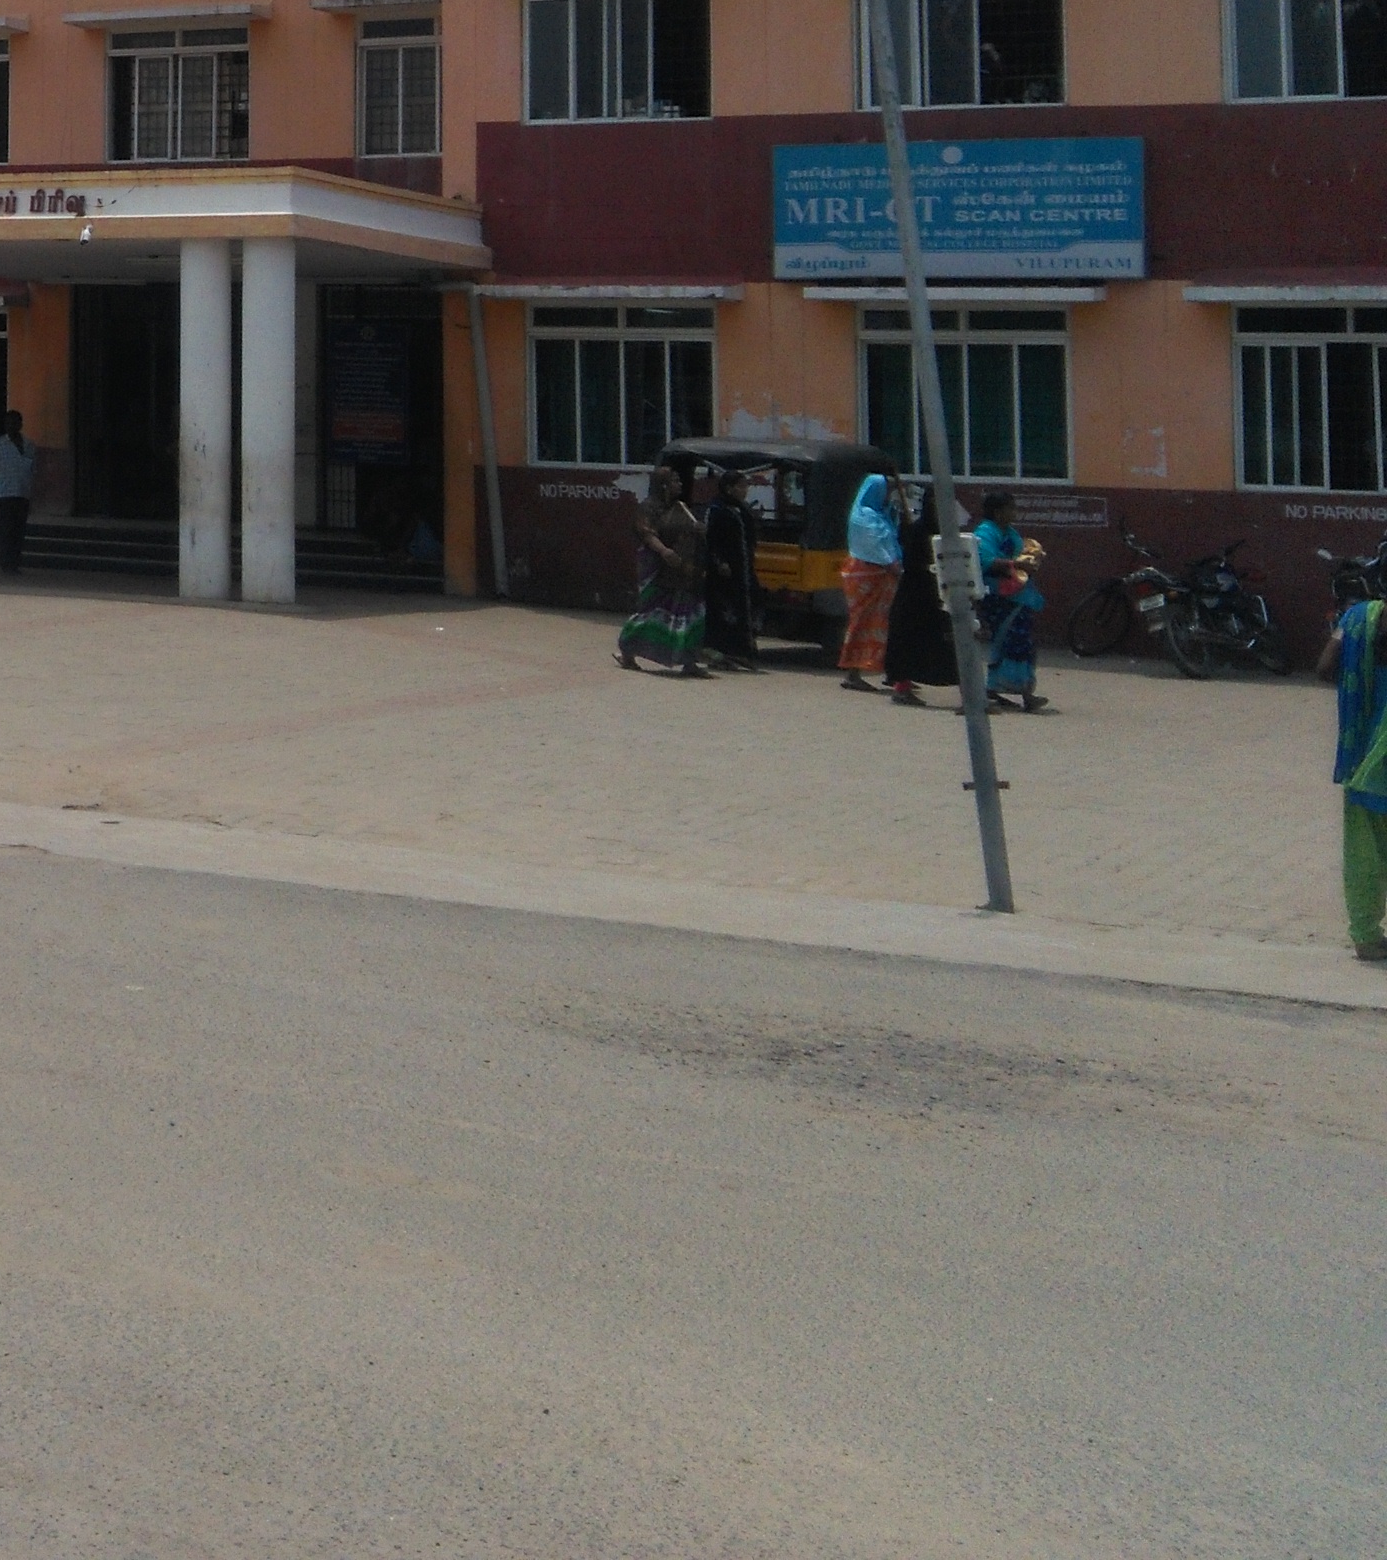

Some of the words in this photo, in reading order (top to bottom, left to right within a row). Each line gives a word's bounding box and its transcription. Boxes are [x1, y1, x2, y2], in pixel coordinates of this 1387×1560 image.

[30, 188, 86, 217] பிரிவு
[954, 208, 1022, 222] SCAN
[1028, 207, 1129, 222] CENTRE
[539, 483, 558, 498] NO
[558, 482, 621, 500] PARKING
[1285, 504, 1308, 519] NO
